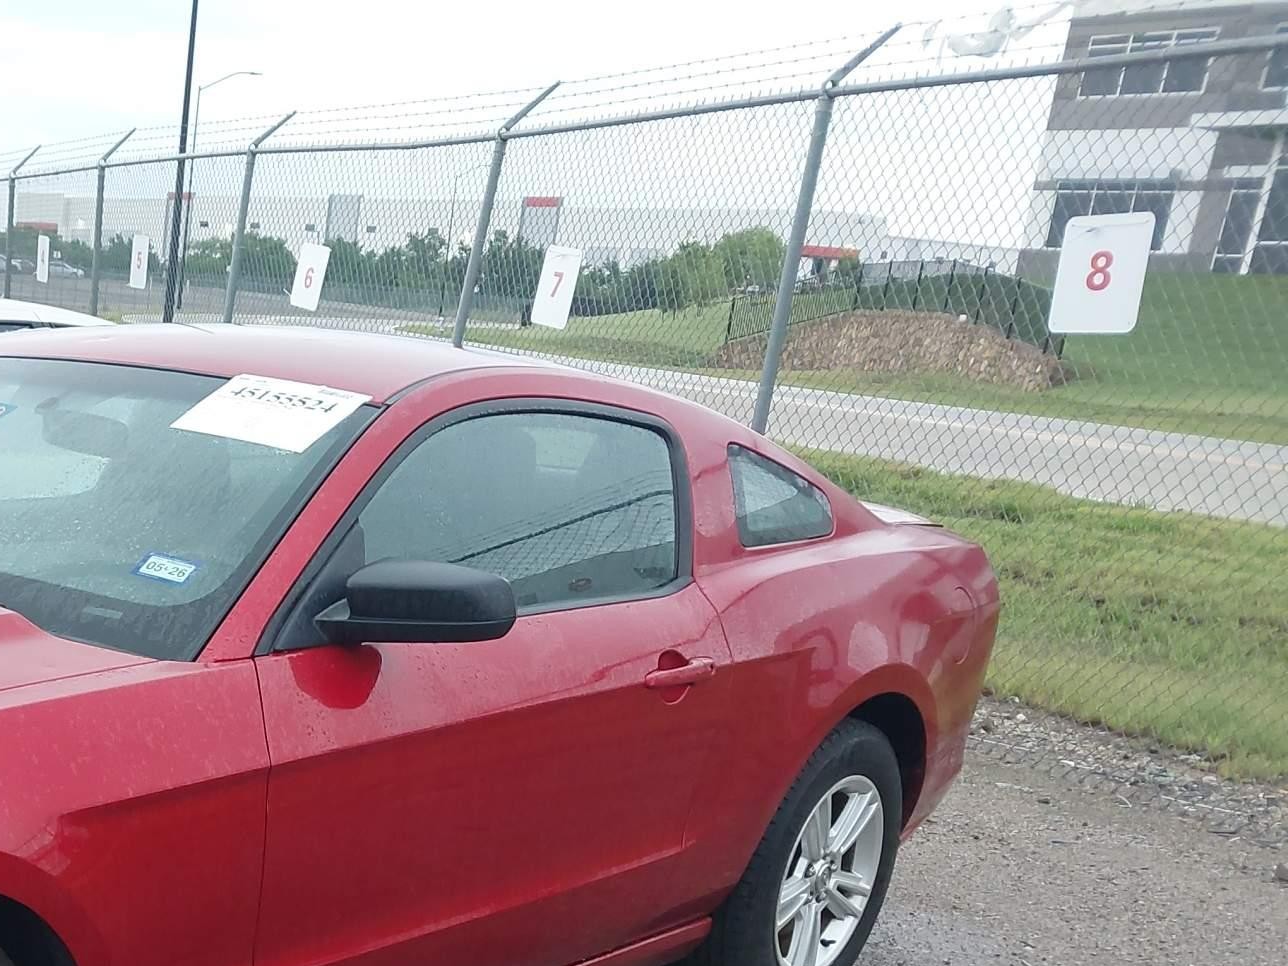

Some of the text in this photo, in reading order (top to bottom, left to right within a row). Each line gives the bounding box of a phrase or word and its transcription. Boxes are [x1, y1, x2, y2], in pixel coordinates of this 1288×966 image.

[136, 252, 142, 269] 5
[1085, 250, 1114, 292] 8
[304, 267, 315, 289] 6
[551, 272, 564, 298] 7
[231, 387, 338, 412] 45155524
